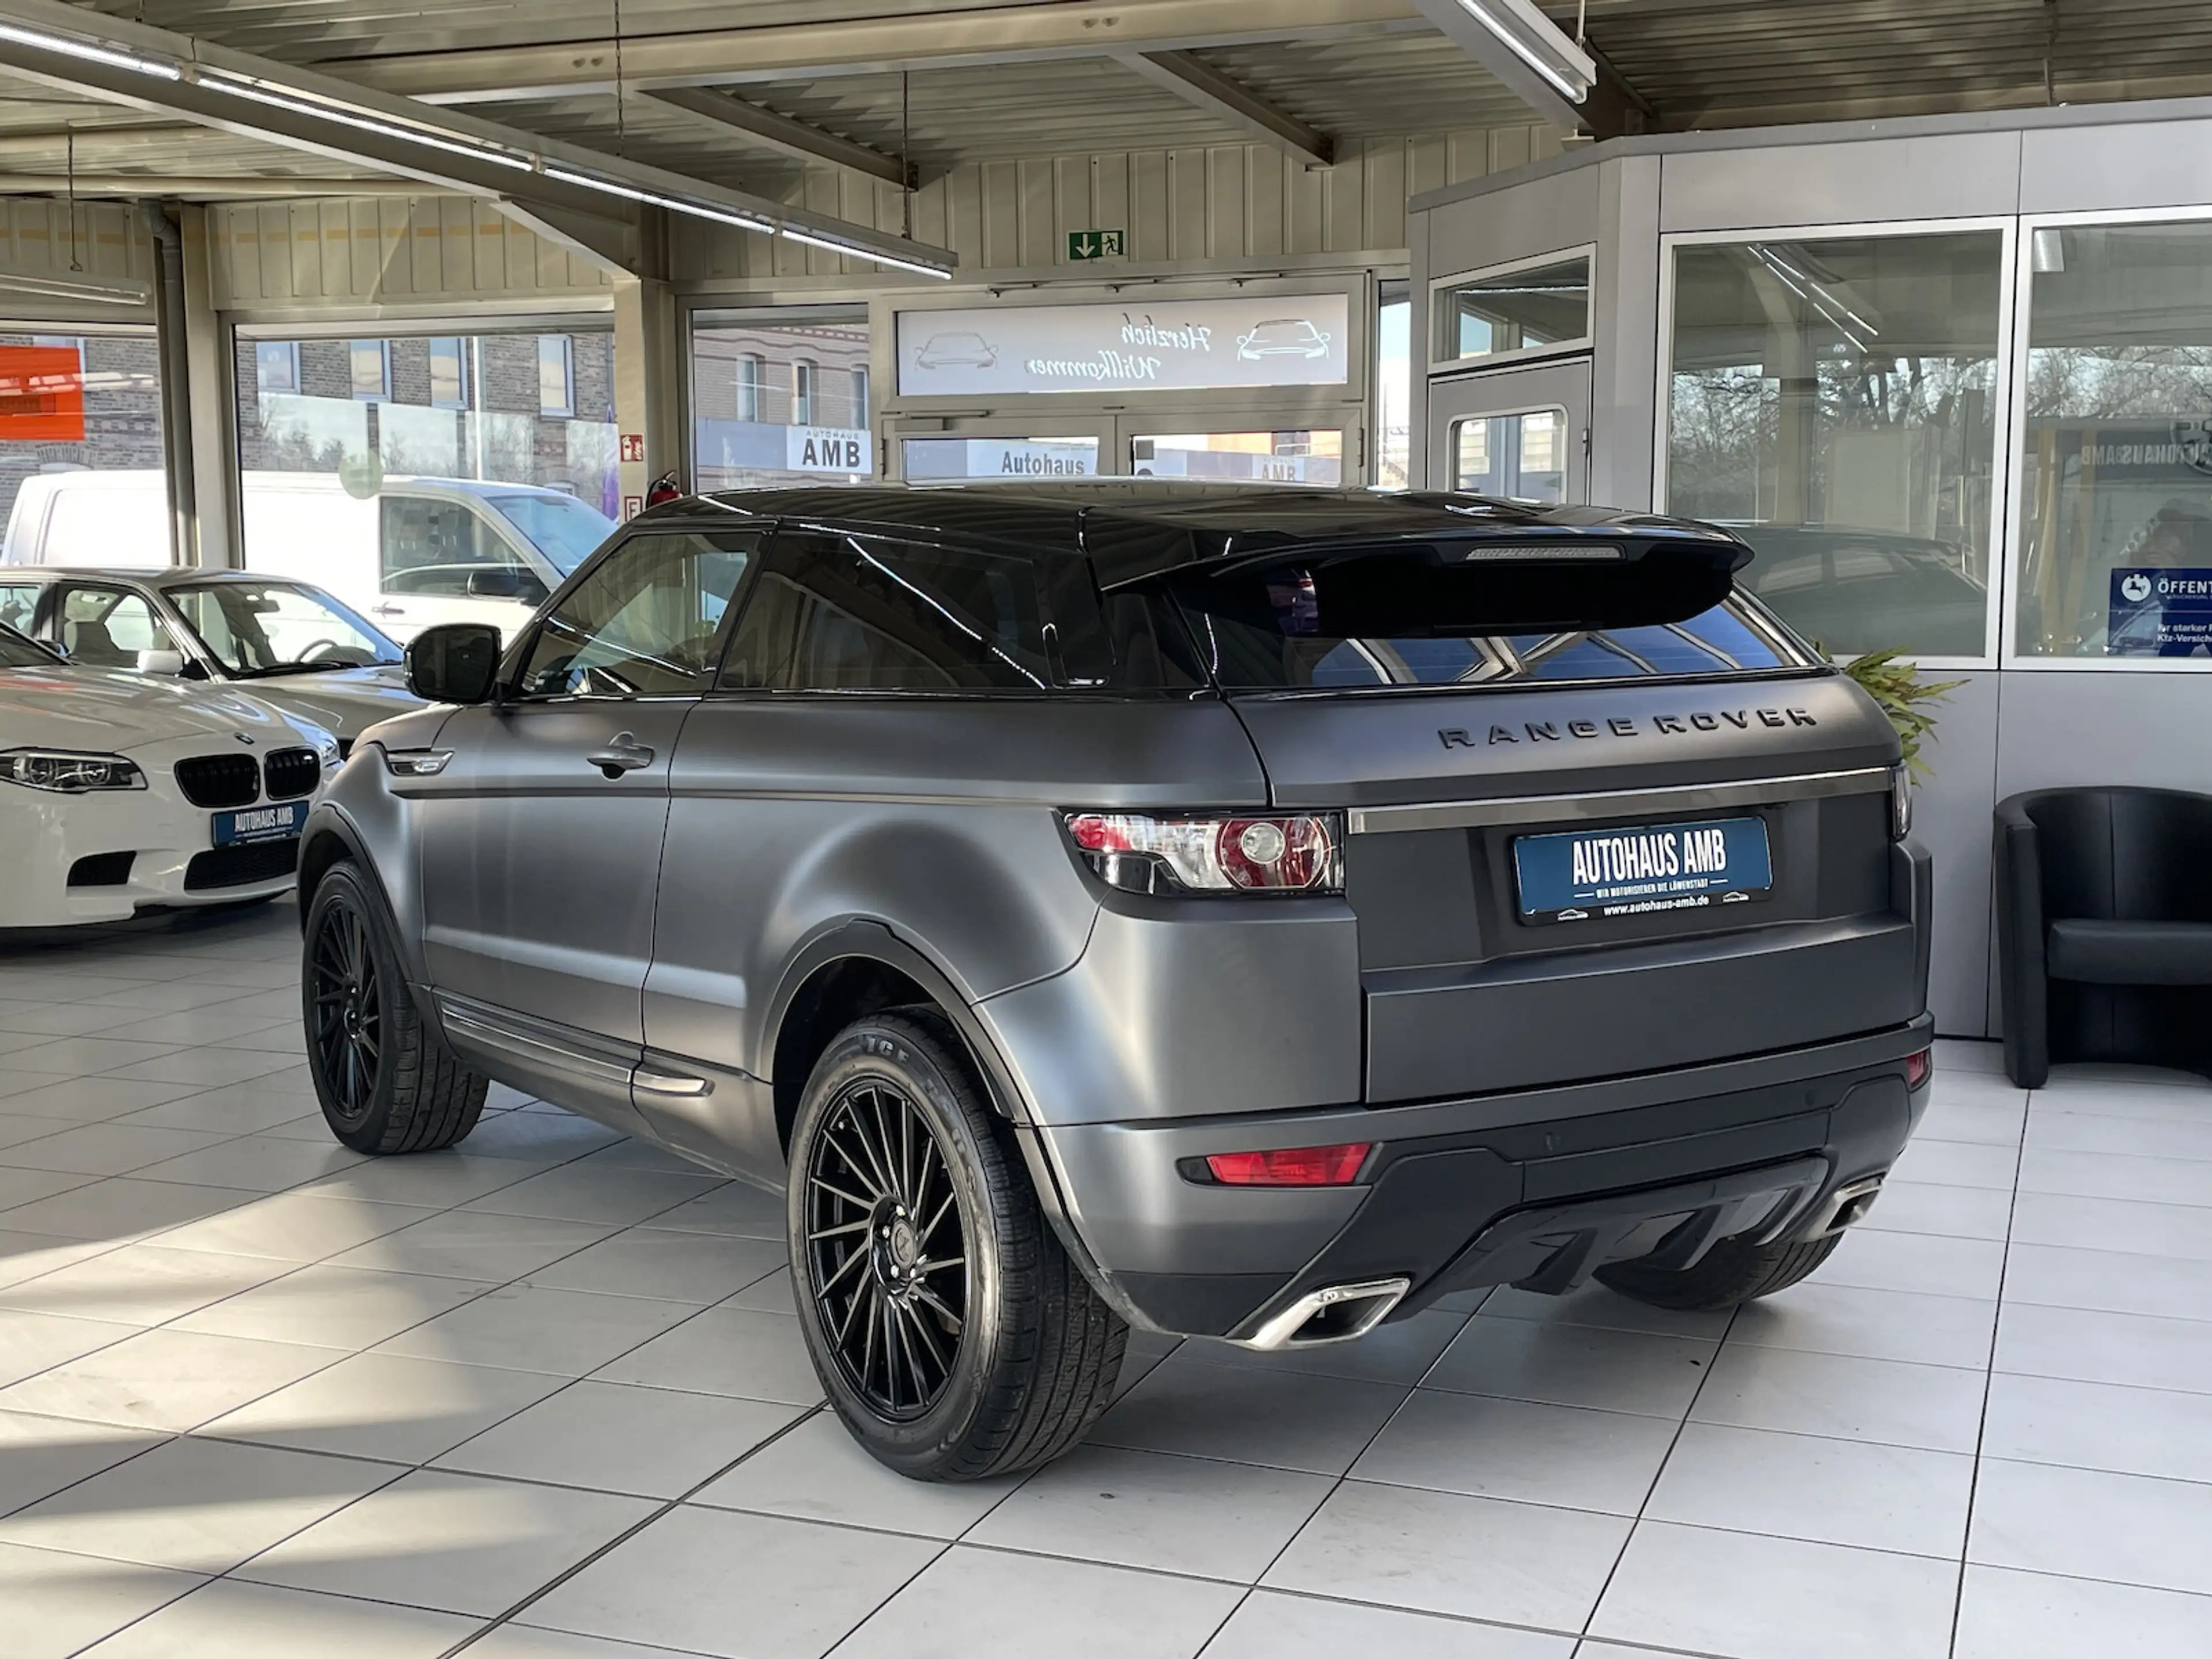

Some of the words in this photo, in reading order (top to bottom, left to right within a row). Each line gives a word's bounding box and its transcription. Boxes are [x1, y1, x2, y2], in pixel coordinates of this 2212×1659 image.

[806, 431, 859, 440] AUTOHAUS
[802, 438, 860, 467] AMB
[1002, 451, 1084, 474] Autohaus
[629, 502, 637, 518] F
[1438, 716, 1639, 748] RANGE
[1653, 707, 1817, 734] ROVER
[234, 809, 276, 832] AUTOHAUS
[276, 806, 294, 825] AMB
[1573, 832, 1678, 885] AUTOHAUS
[1684, 829, 1726, 874] AMB
[1603, 895, 1710, 916] www.autohaus-amb.de
